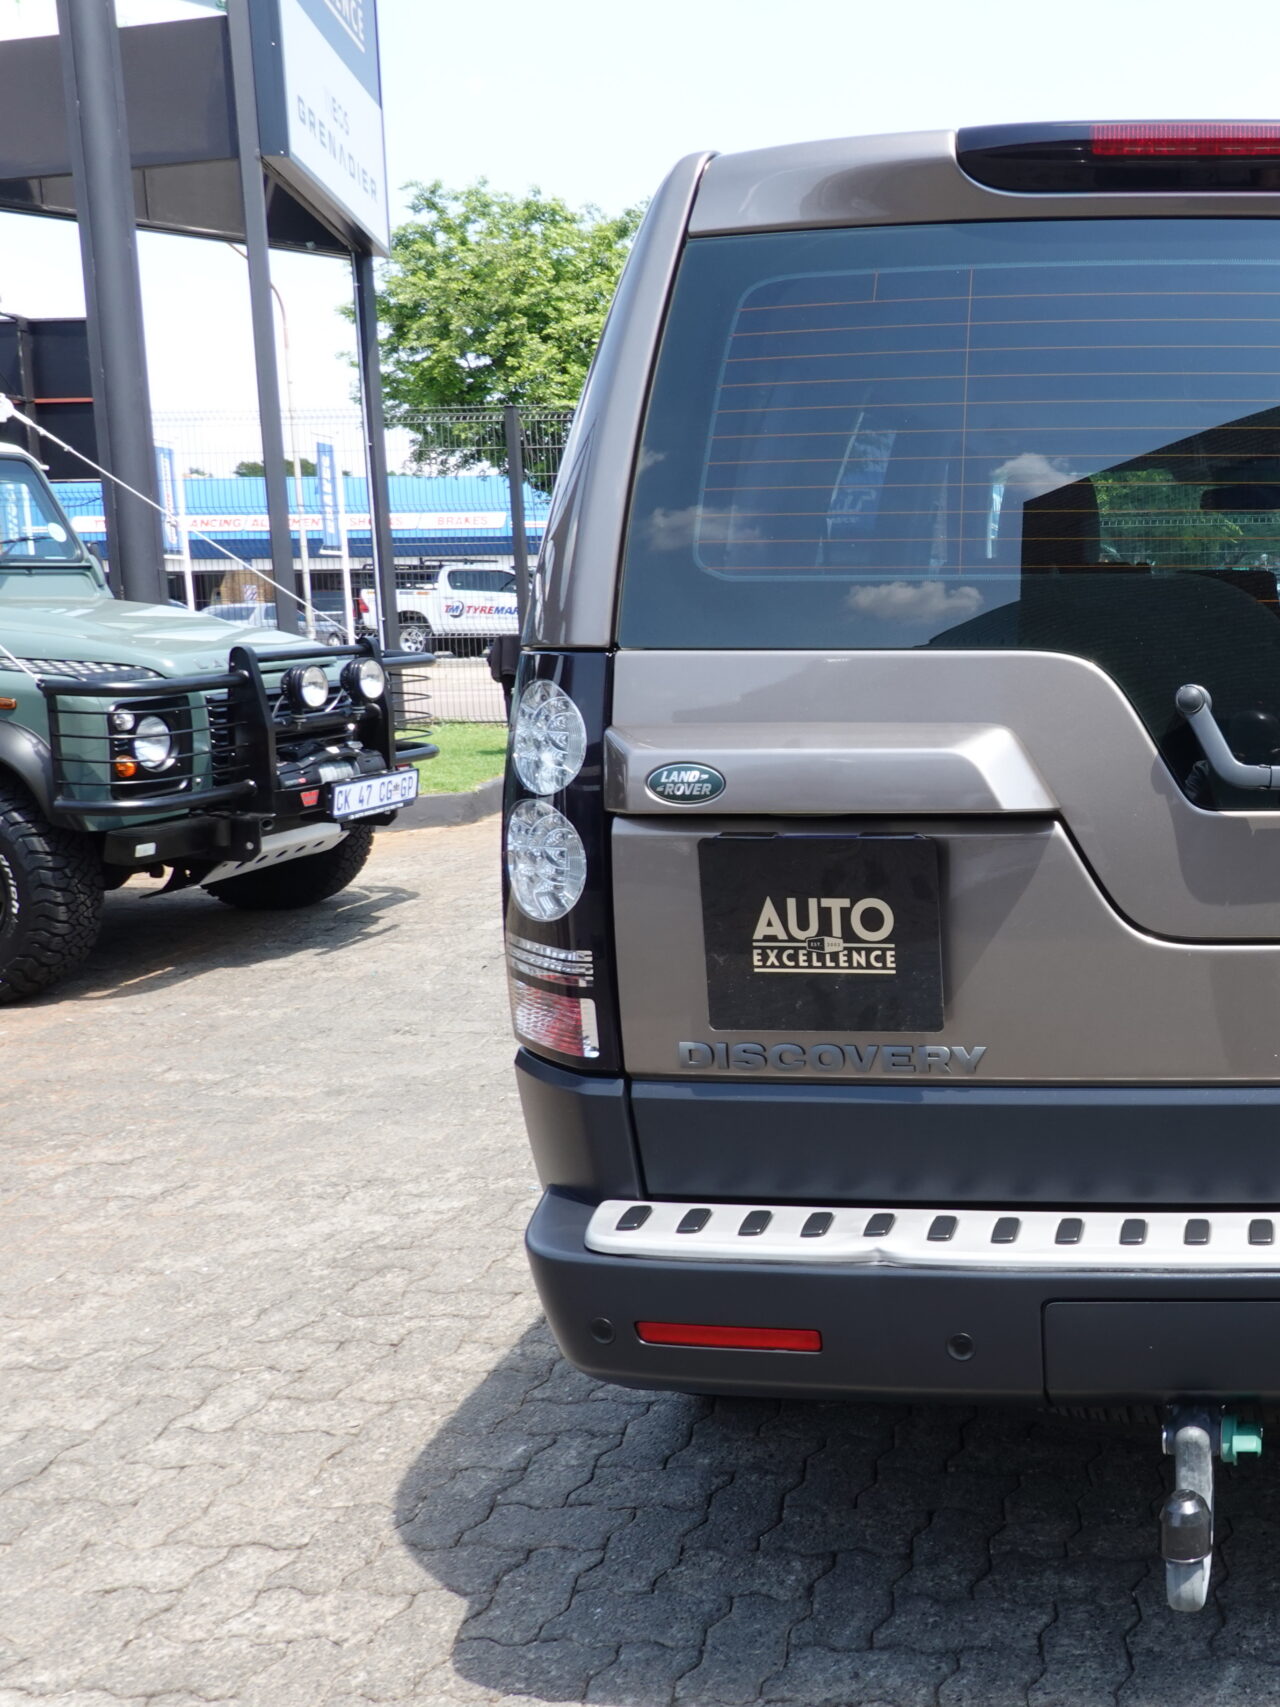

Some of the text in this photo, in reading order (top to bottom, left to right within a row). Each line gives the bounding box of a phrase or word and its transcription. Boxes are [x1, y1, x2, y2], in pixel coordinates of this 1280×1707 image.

[297, 94, 379, 203] GRENADIER
[190, 519, 242, 528] ANCING
[437, 516, 488, 526] BRAKES
[660, 770, 700, 783] LAND
[664, 783, 712, 796] ROVER
[336, 776, 414, 811] CK 47 CG GP
[752, 896, 895, 942] AUTO
[752, 949, 897, 968] EXCELLENCE
[678, 1041, 987, 1074] DISCOVERY
